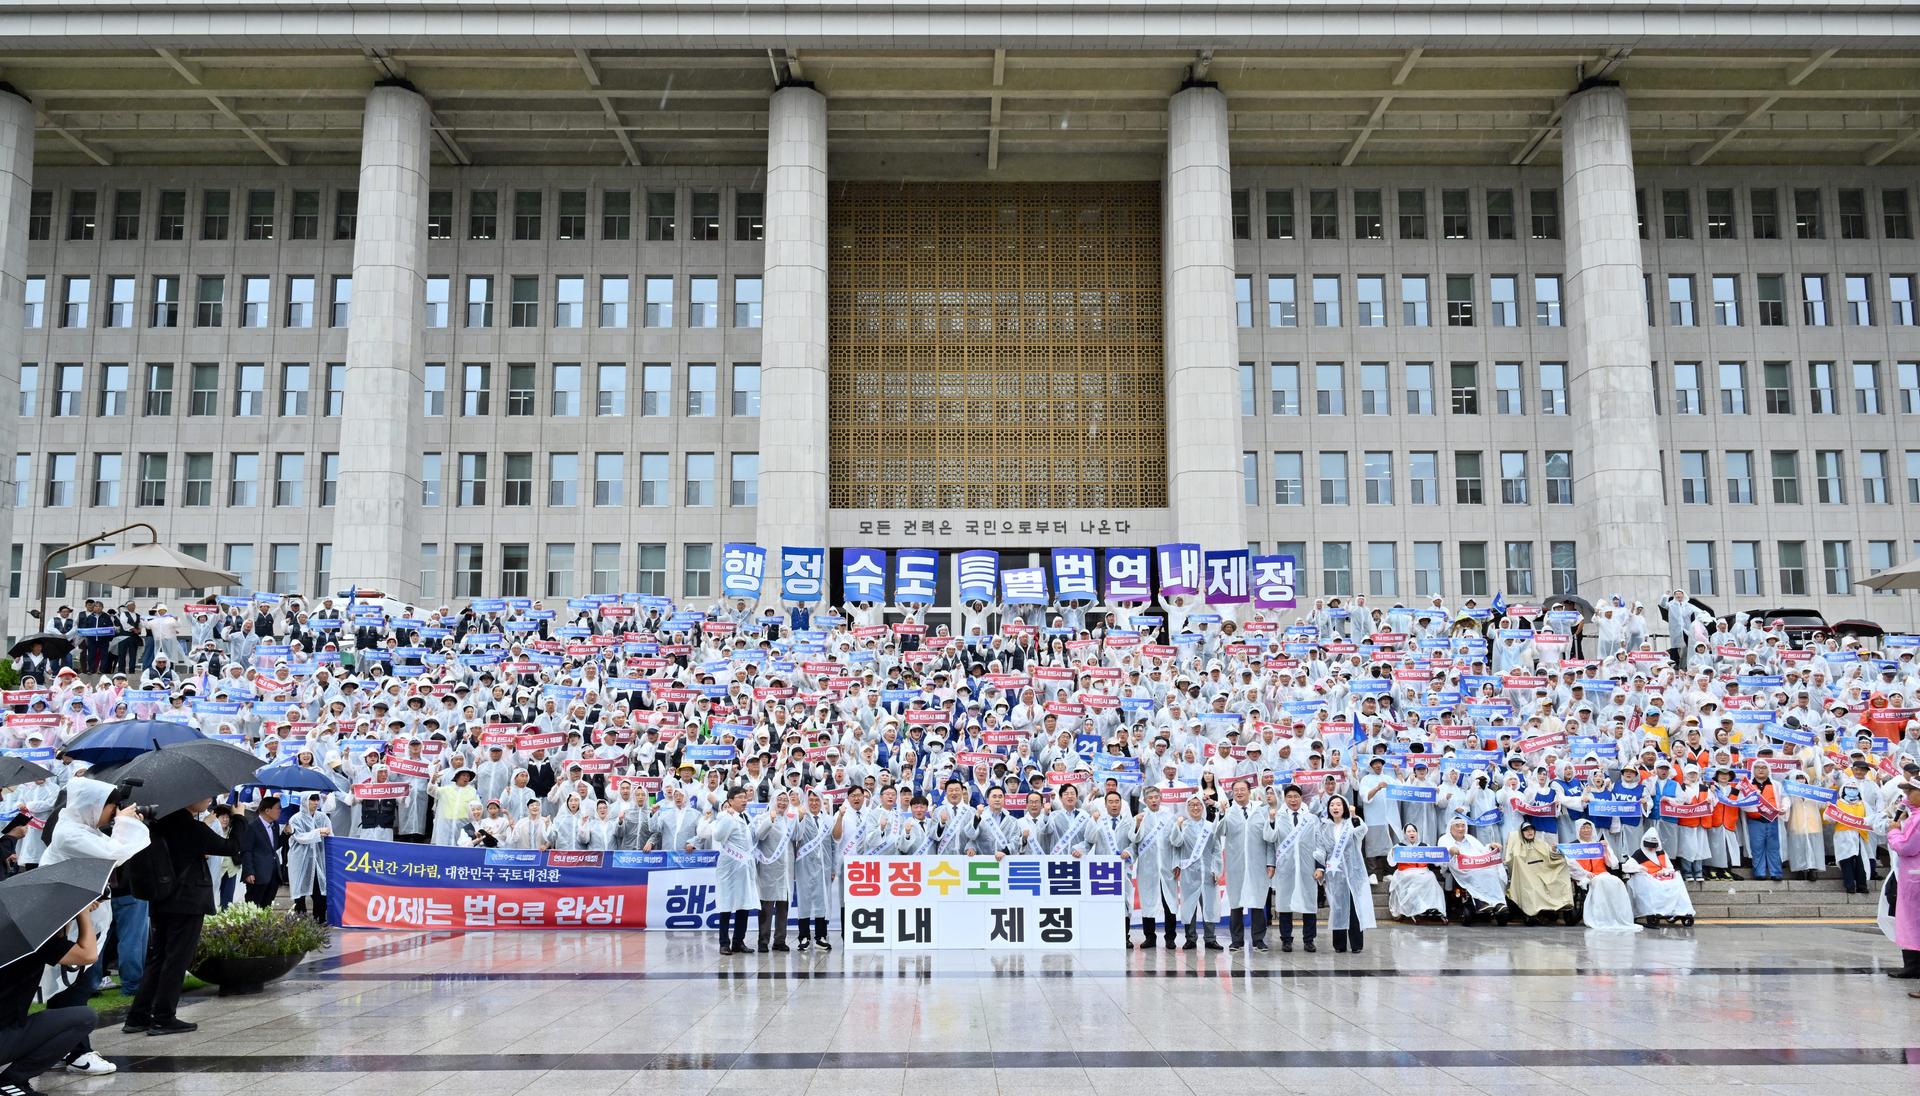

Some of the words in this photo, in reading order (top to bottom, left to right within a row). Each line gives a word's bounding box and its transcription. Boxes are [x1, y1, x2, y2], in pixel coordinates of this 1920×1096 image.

[859, 520, 890, 536] 모든
[904, 520, 952, 536] 권력은
[965, 520, 1066, 536] 국민으로부터
[1080, 520, 1130, 535] 나온다
[1078, 741, 1098, 755] 21
[1616, 792, 1636, 802] YWCA
[344, 850, 398, 876] 24년간
[401, 862, 441, 880] 기다림,
[445, 866, 496, 881] 대한민국
[498, 868, 561, 882] 국토대전환
[366, 895, 454, 926] 이제는
[464, 895, 545, 926] 법으로
[555, 894, 624, 926] 완성!
[852, 907, 932, 943] 연내
[990, 907, 1073, 943] 제정
